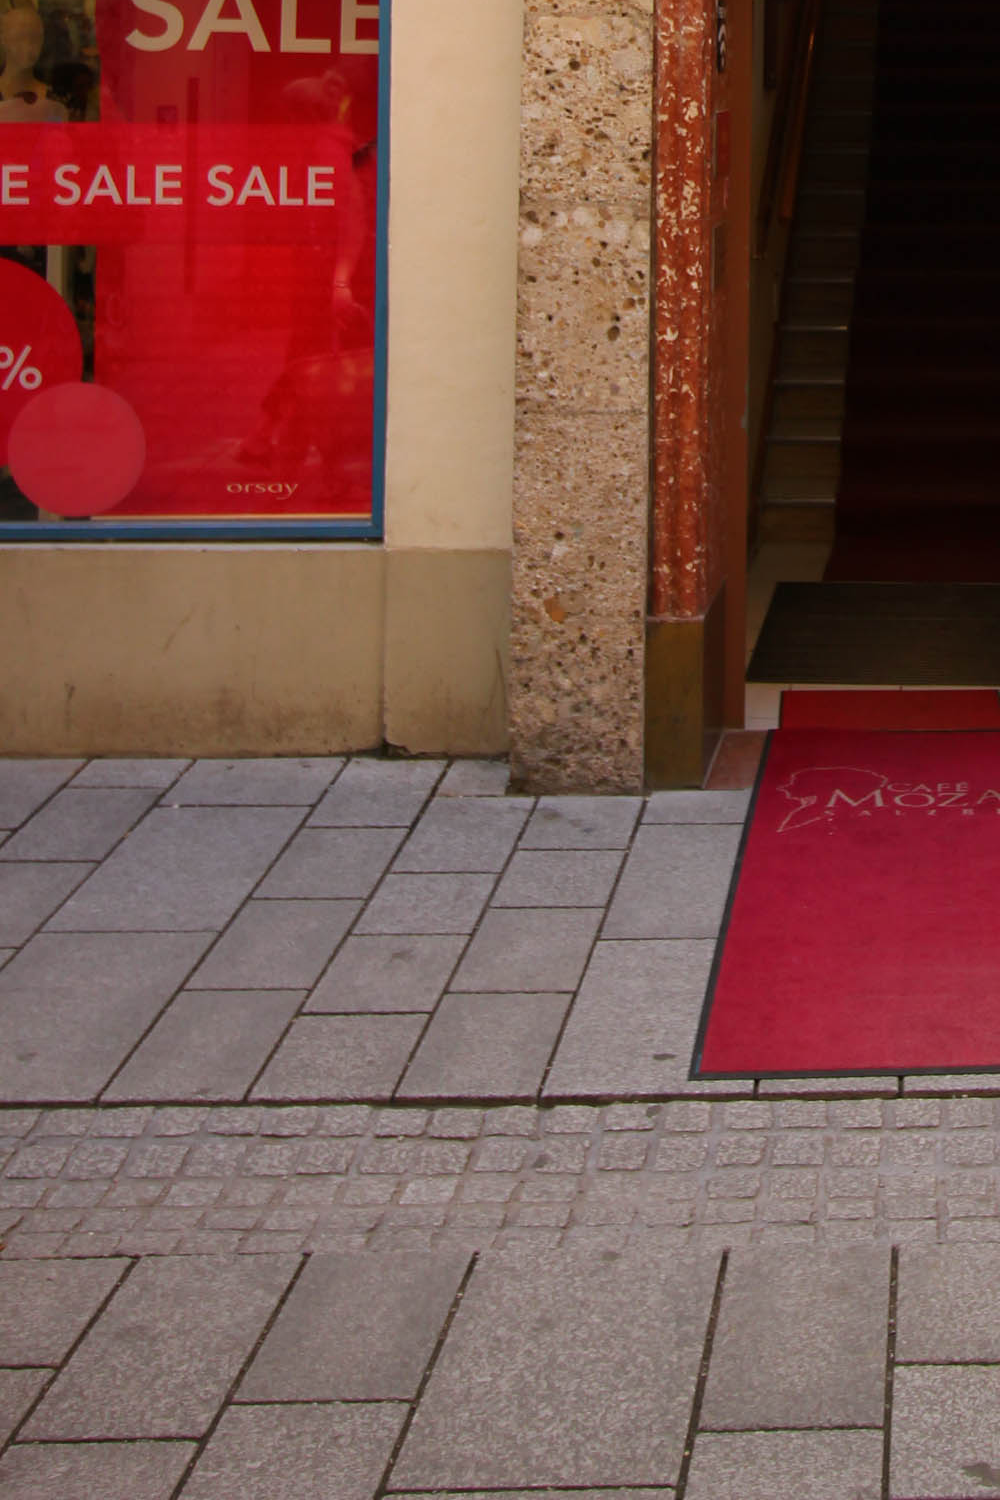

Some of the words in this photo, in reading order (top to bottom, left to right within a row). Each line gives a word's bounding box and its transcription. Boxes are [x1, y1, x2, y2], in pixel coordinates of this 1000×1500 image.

[53, 164, 183, 206] SALE
[206, 164, 336, 207] SALE
[226, 482, 299, 501] orsay
